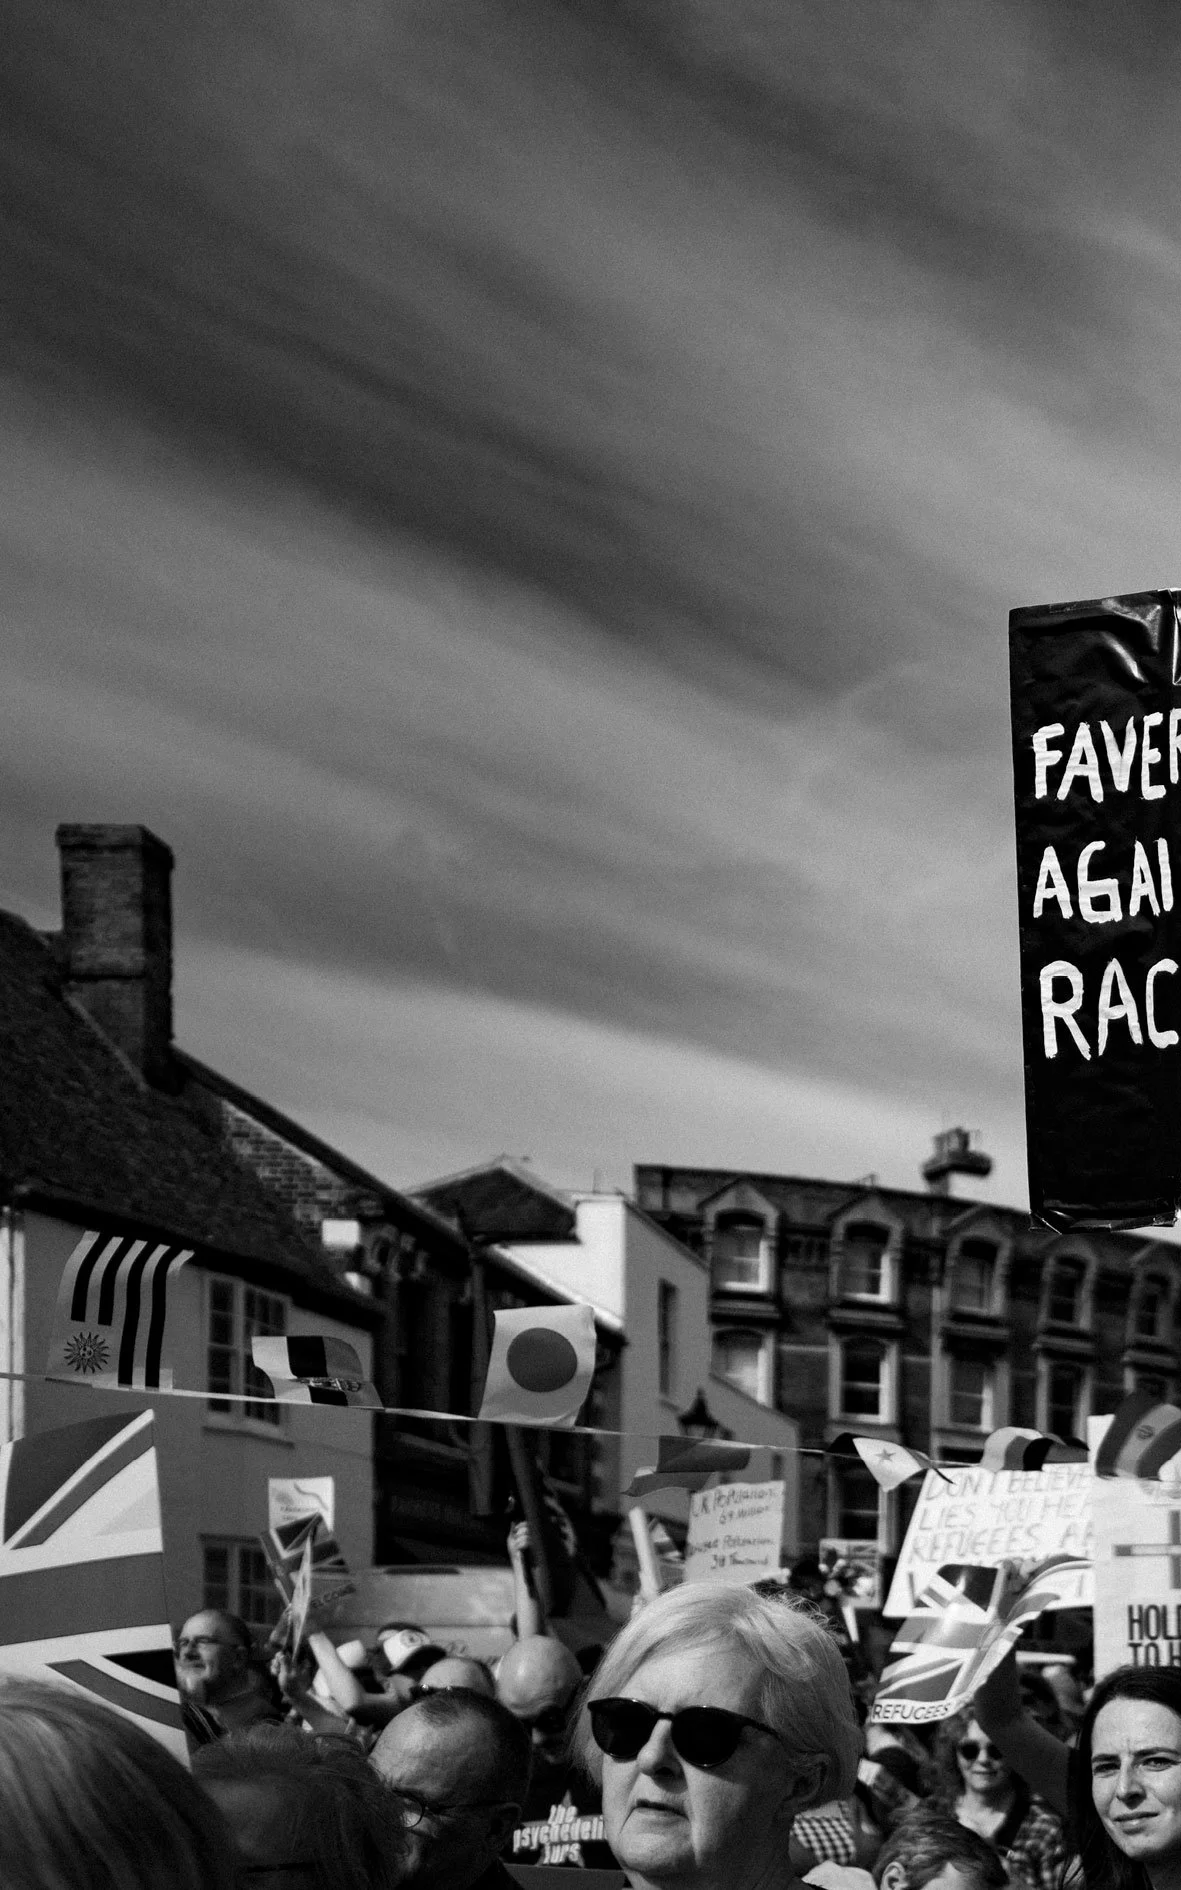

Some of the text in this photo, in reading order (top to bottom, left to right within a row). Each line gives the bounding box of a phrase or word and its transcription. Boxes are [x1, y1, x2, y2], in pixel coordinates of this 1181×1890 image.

[919, 1503, 977, 1531] LIES
[1127, 1641, 1160, 1668] TO
[872, 1702, 951, 1721] REFUGEES
[512, 1814, 608, 1854] psychedeli
